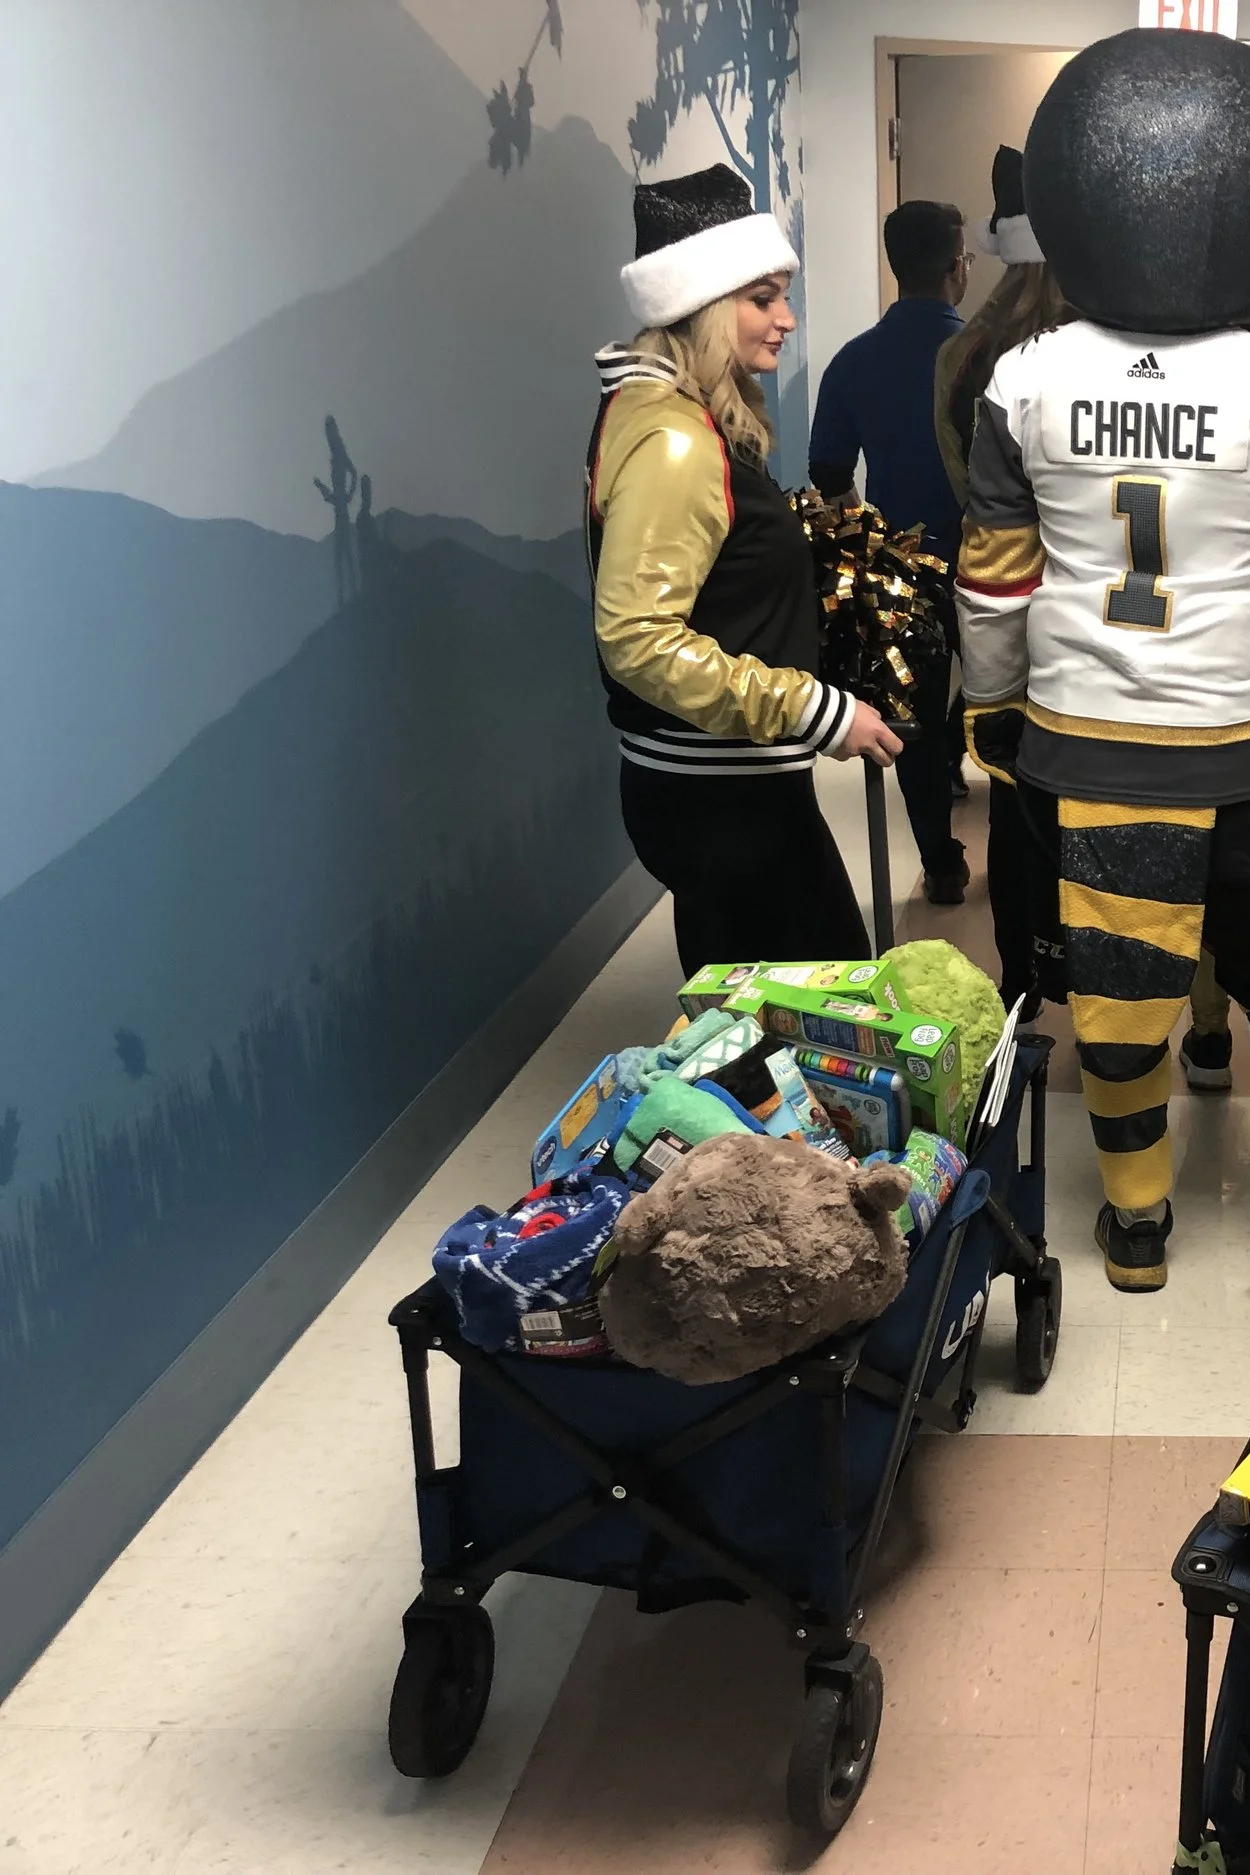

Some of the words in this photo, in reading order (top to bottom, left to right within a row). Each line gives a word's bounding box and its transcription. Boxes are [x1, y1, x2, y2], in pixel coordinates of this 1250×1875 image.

[1127, 367, 1166, 380] adidas
[1070, 399, 1219, 463] CHANCE
[1102, 474, 1175, 634] 1
